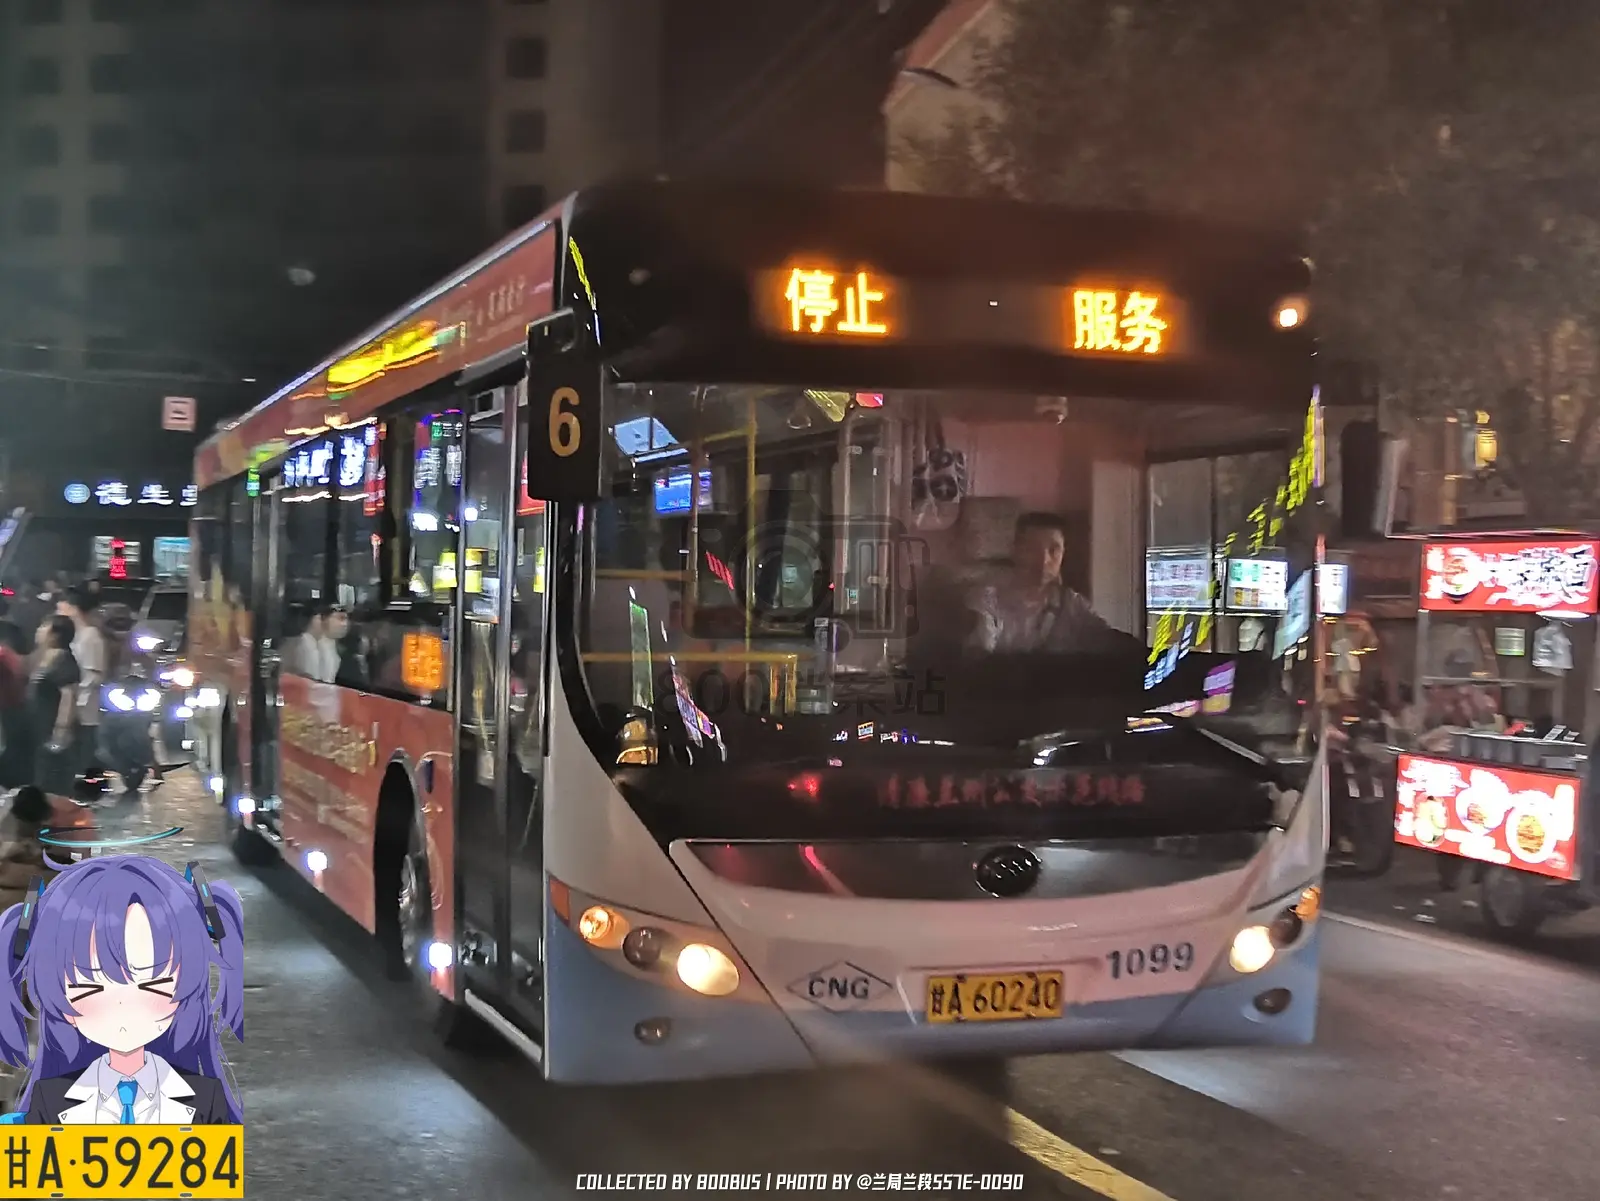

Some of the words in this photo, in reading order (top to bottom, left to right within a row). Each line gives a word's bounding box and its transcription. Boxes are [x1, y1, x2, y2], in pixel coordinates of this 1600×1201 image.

[785, 267, 887, 334] 停止
[1072, 288, 1168, 354] 服务
[549, 386, 581, 457] 6
[1105, 941, 1195, 980] 1099
[807, 976, 871, 1001] CNG
